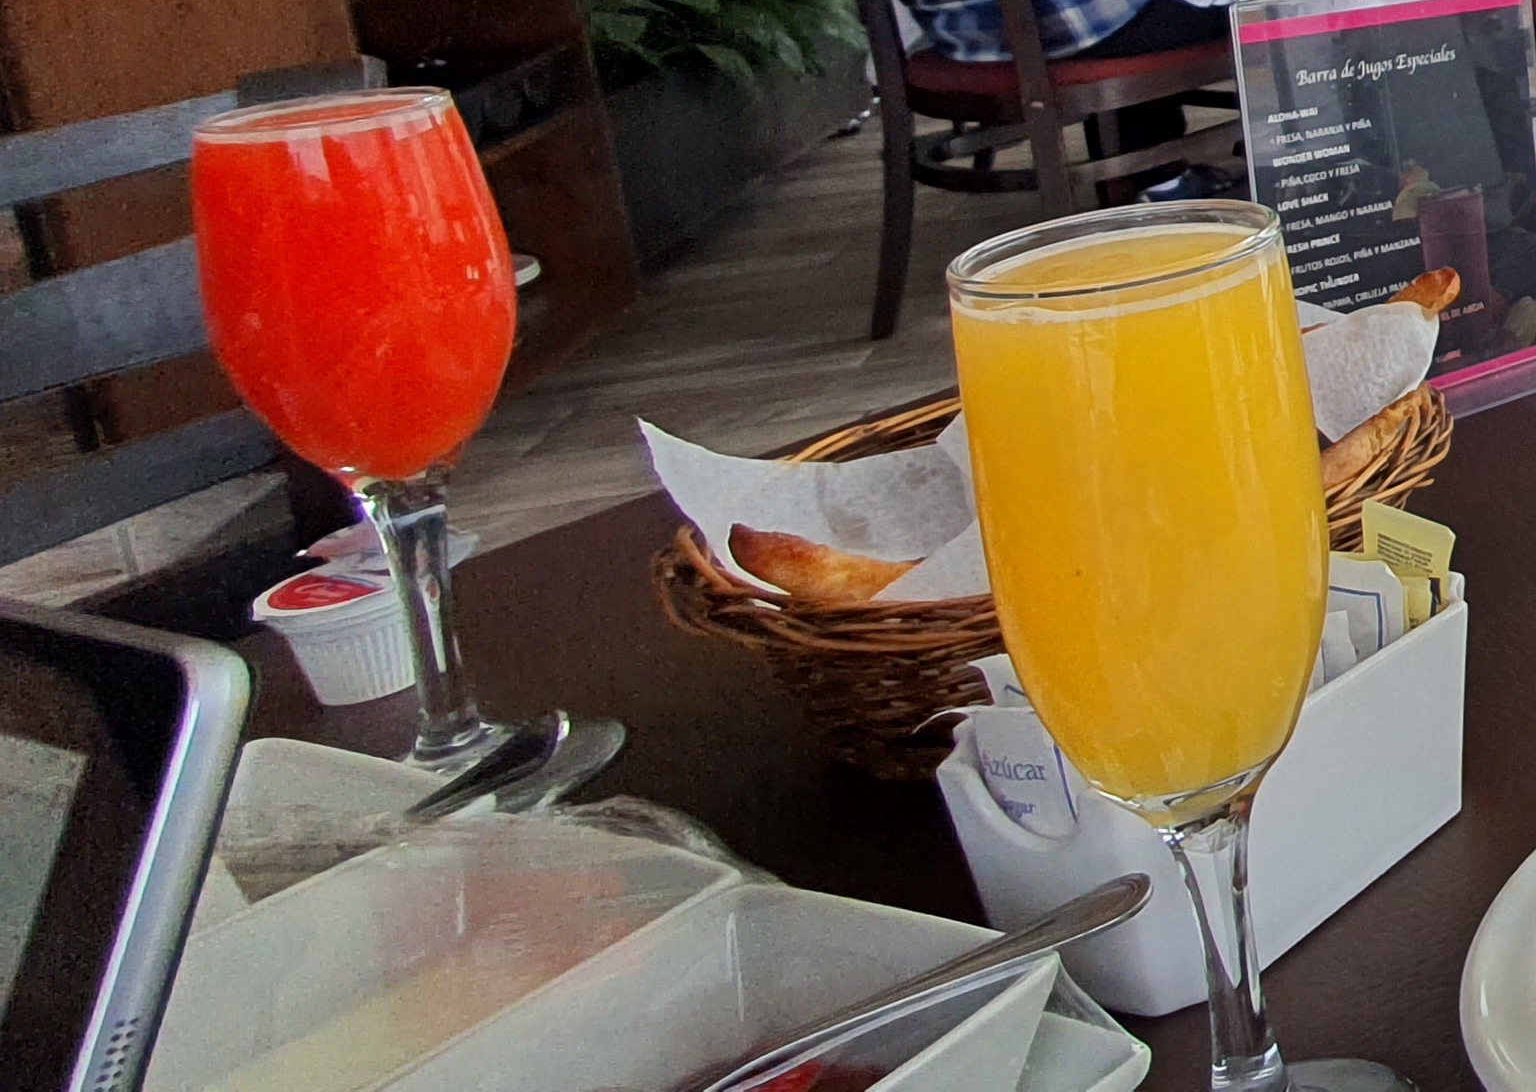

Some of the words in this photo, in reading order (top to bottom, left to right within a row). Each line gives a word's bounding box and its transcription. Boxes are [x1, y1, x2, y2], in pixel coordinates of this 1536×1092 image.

[1296, 68, 1337, 86] Barra
[1340, 58, 1355, 79] de
[1356, 59, 1392, 81] Jugos
[1395, 43, 1456, 75] Especiales
[1273, 151, 1313, 167] WONDER
[1314, 144, 1350, 159] WOMAN
[1277, 199, 1300, 212] LOVE
[1301, 192, 1329, 207] SHACK
[1315, 210, 1349, 225] MANGO
[1286, 240, 1309, 254] RESH
[1310, 233, 1341, 249] PRINCE
[1353, 247, 1373, 260] PIÑA
[1381, 236, 1421, 253] MANZANA
